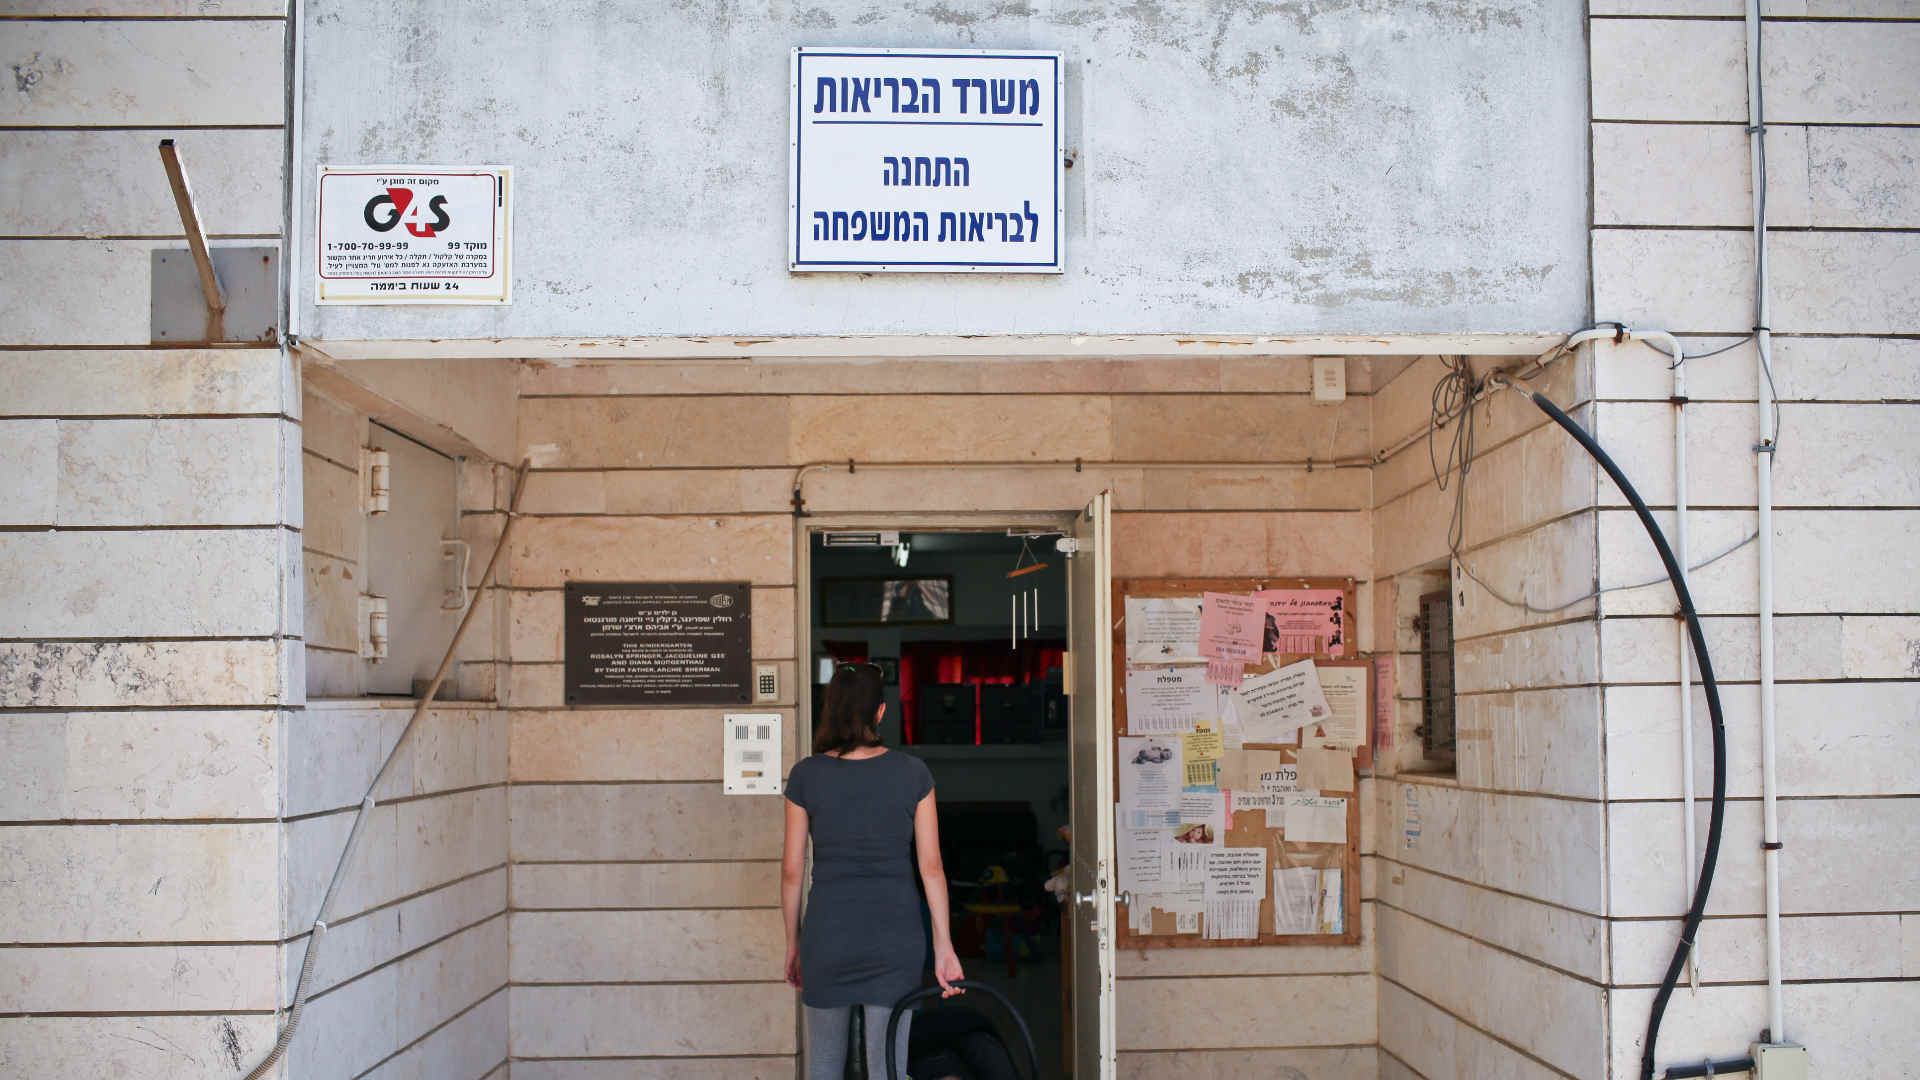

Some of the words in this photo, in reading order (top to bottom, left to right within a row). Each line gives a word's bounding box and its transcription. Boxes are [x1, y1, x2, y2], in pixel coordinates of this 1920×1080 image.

[813, 76, 941, 113] הבריאות
[952, 78, 1040, 115] משרד
[883, 156, 970, 187] התחנה
[390, 178, 405, 186] מוגן
[419, 178, 439, 187] מקום
[364, 188, 450, 237] G4S
[937, 200, 1039, 242] לבריאות
[813, 211, 929, 242] המשפחה
[327, 242, 409, 252] 1-700-70-99-99
[447, 241, 461, 251] 99
[464, 241, 488, 252] מוקד
[370, 282, 406, 291] ביממה
[410, 282, 440, 291] שעות
[444, 282, 459, 291] 24
[1157, 675, 1182, 684] מטפלת
